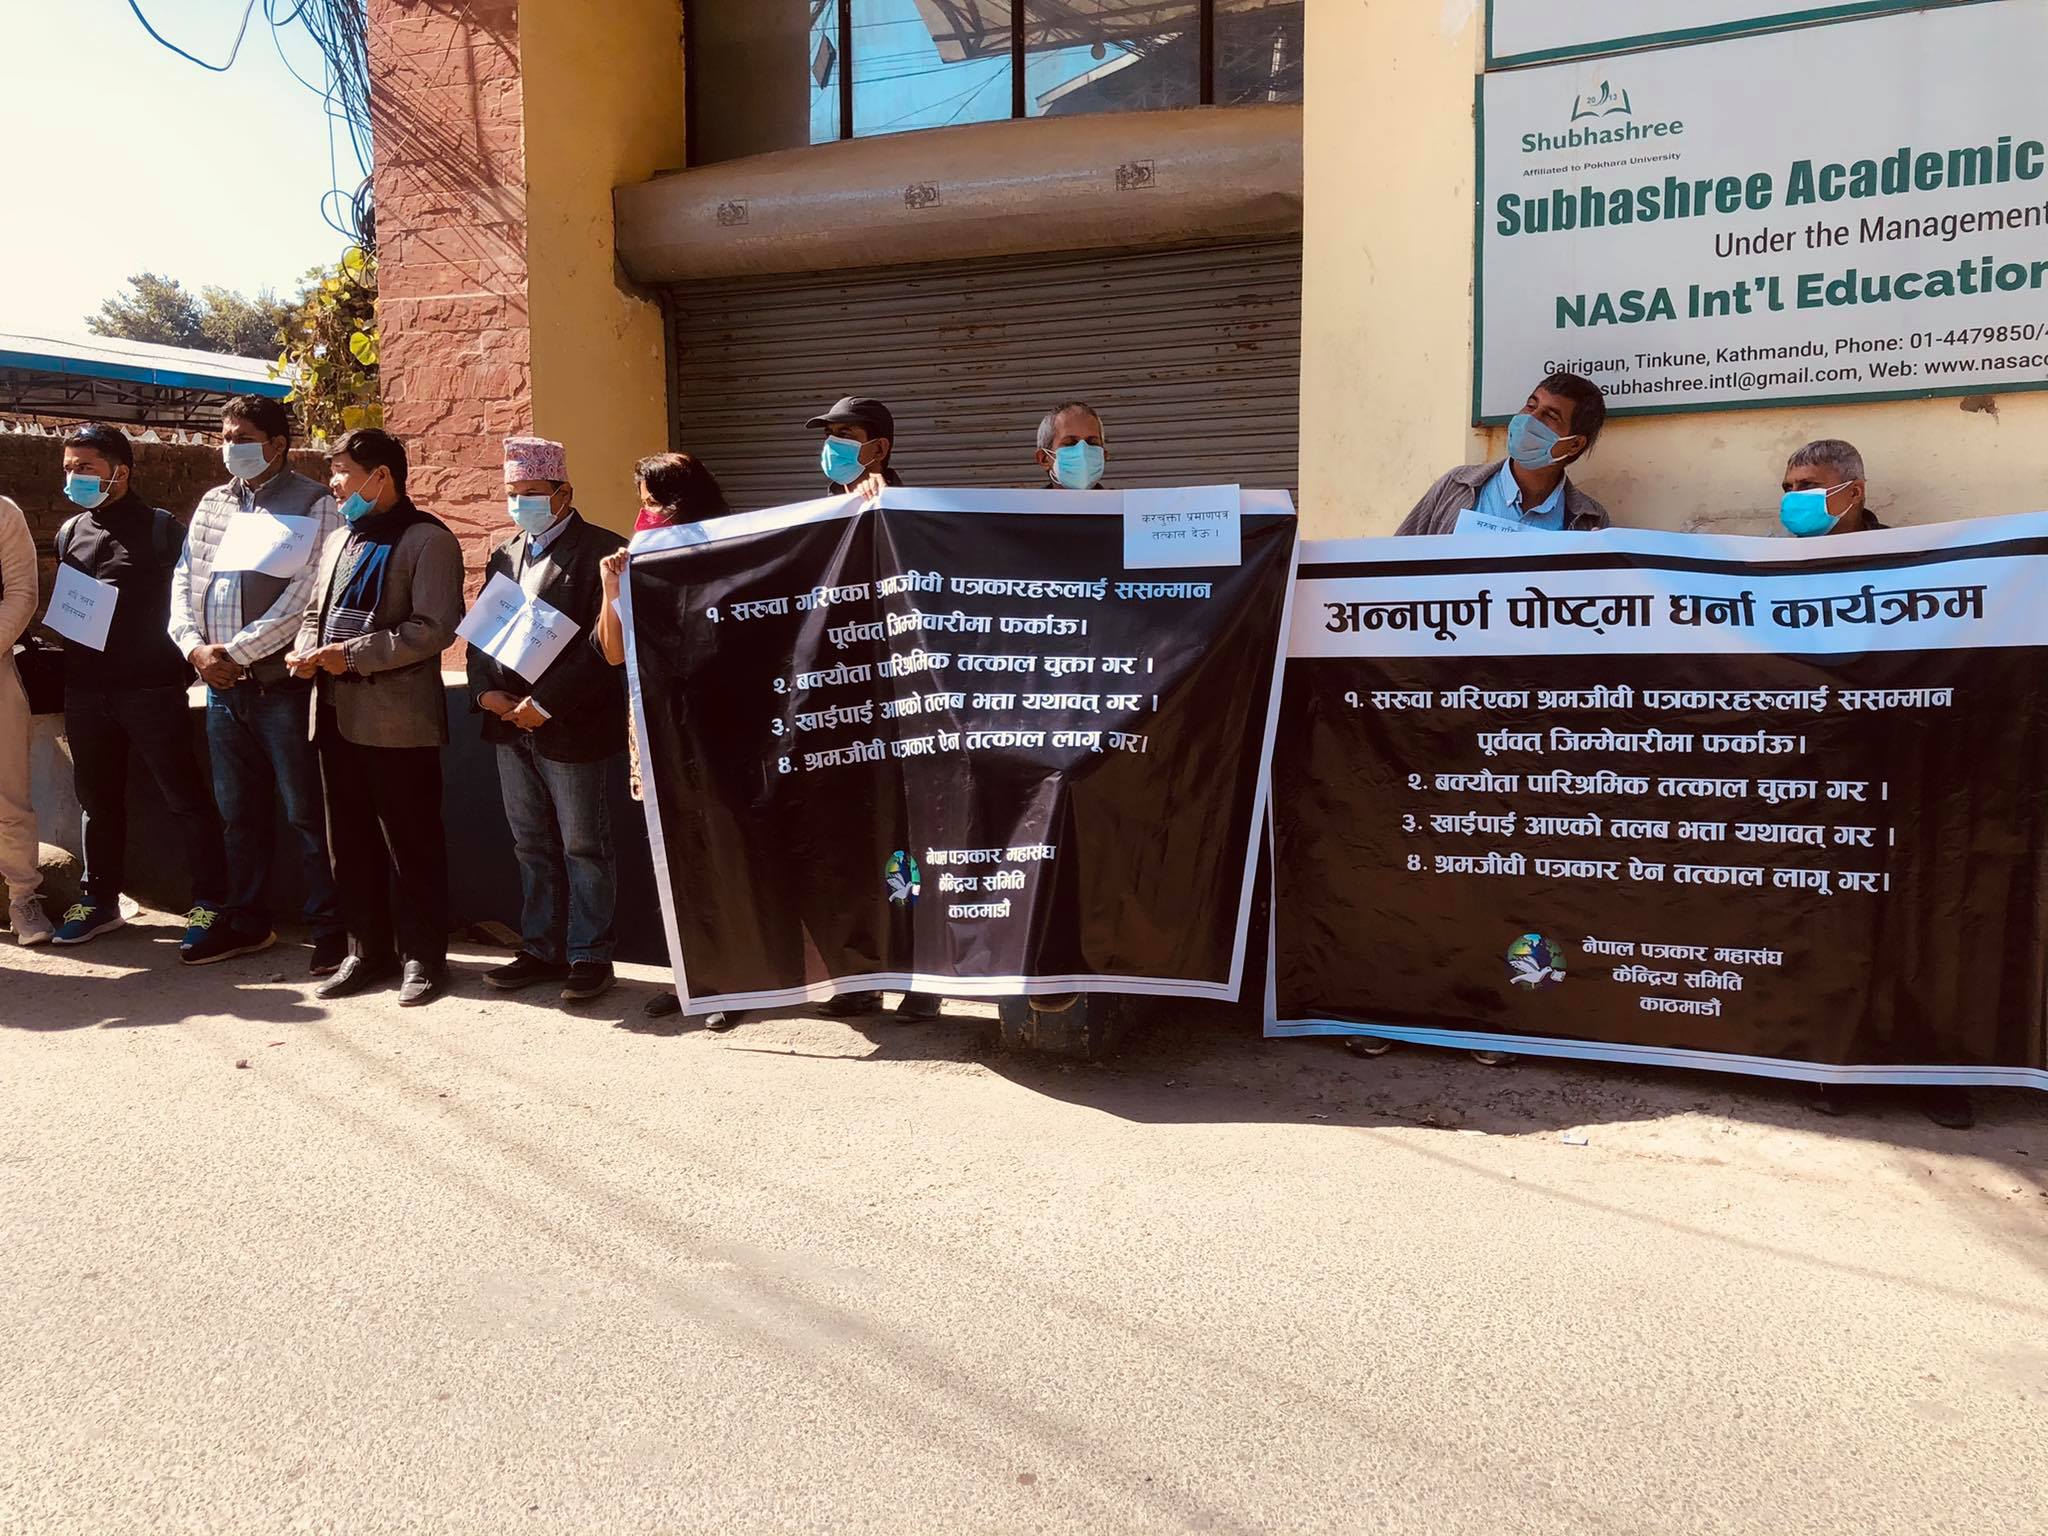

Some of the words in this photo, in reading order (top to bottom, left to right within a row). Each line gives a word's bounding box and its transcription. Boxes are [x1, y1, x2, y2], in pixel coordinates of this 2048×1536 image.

[1522, 120, 1684, 153] Shubhashree
[1523, 165, 1568, 176] Affiliated
[1584, 159, 1627, 170] Pokhara
[1630, 153, 1682, 165] University
[1496, 170, 1774, 237] Subhashree
[1785, 135, 2045, 206] Academic
[1715, 227, 1796, 258] Under
[1805, 221, 1849, 249] the
[1556, 287, 1677, 329] NASA
[1543, 356, 1630, 376] Gairigaun,
[1635, 351, 1711, 369] Tinkune,
[1716, 341, 1828, 364] Kathmandu,
[1835, 336, 1903, 354] Phone:
[1869, 361, 1918, 378] Web:
[795, 582, 870, 612] गरिएका
[875, 569, 944, 600] श्रमजीवी
[1115, 581, 1212, 601] ससम्मान
[827, 620, 886, 649] पूर्ववत्
[887, 608, 991, 637] जिम्मेवारीमा
[1323, 589, 1493, 642] अन्नपूर्ण
[1669, 590, 1756, 627] धर्ना
[1771, 585, 1987, 629] कार्यक्रम
[796, 661, 871, 691] बक्यौता
[877, 649, 951, 679] पारिश्रमिक
[958, 654, 1037, 673] तत्काल
[1044, 656, 1096, 678] चुक्ता
[795, 699, 873, 732] खाईपाई
[880, 691, 922, 718] आएको
[924, 692, 966, 715] तलब
[972, 693, 1014, 712] भत्ता
[1023, 693, 1100, 715] यथावत्
[1440, 685, 1530, 711] गरिएका
[1538, 684, 1635, 711] श्रमजीवी
[1838, 687, 1954, 711] ससम्मान
[803, 738, 886, 772] श्रमजीवी
[891, 733, 936, 759] पत्रकार
[937, 729, 960, 752] ऐन
[966, 731, 1046, 750] तत्काल
[1052, 731, 1103, 754] लागू
[1477, 728, 1544, 756] पूर्ववत्
[1550, 727, 1694, 753] जिम्मेवारीमा
[1435, 768, 1520, 793] बक्यौता
[1527, 769, 1650, 795] पारिश्रमिक
[1657, 777, 1749, 798] तत्काल
[1757, 779, 1818, 804] चुक्ता
[1430, 811, 1518, 838] खाईपाई
[1524, 812, 1603, 837] आएको
[1611, 819, 1671, 839] तलब
[1677, 821, 1727, 842] भत्ता
[1735, 822, 1826, 849] यथावत्
[949, 848, 1002, 865] पत्रकार
[1006, 842, 1056, 862] महासंघ
[982, 869, 1026, 892] समिति
[1434, 852, 1526, 876] श्रमजीवी
[1534, 858, 1621, 881] पत्रकार
[1629, 856, 1665, 882] ऐन
[1673, 863, 1765, 887] तत्काल
[1772, 868, 1834, 896] लागू
[1582, 936, 1635, 957] नेपाल
[1640, 942, 1709, 962] पत्रकार
[1713, 947, 1784, 967] महासंघ
[1684, 970, 1744, 991] समिति
